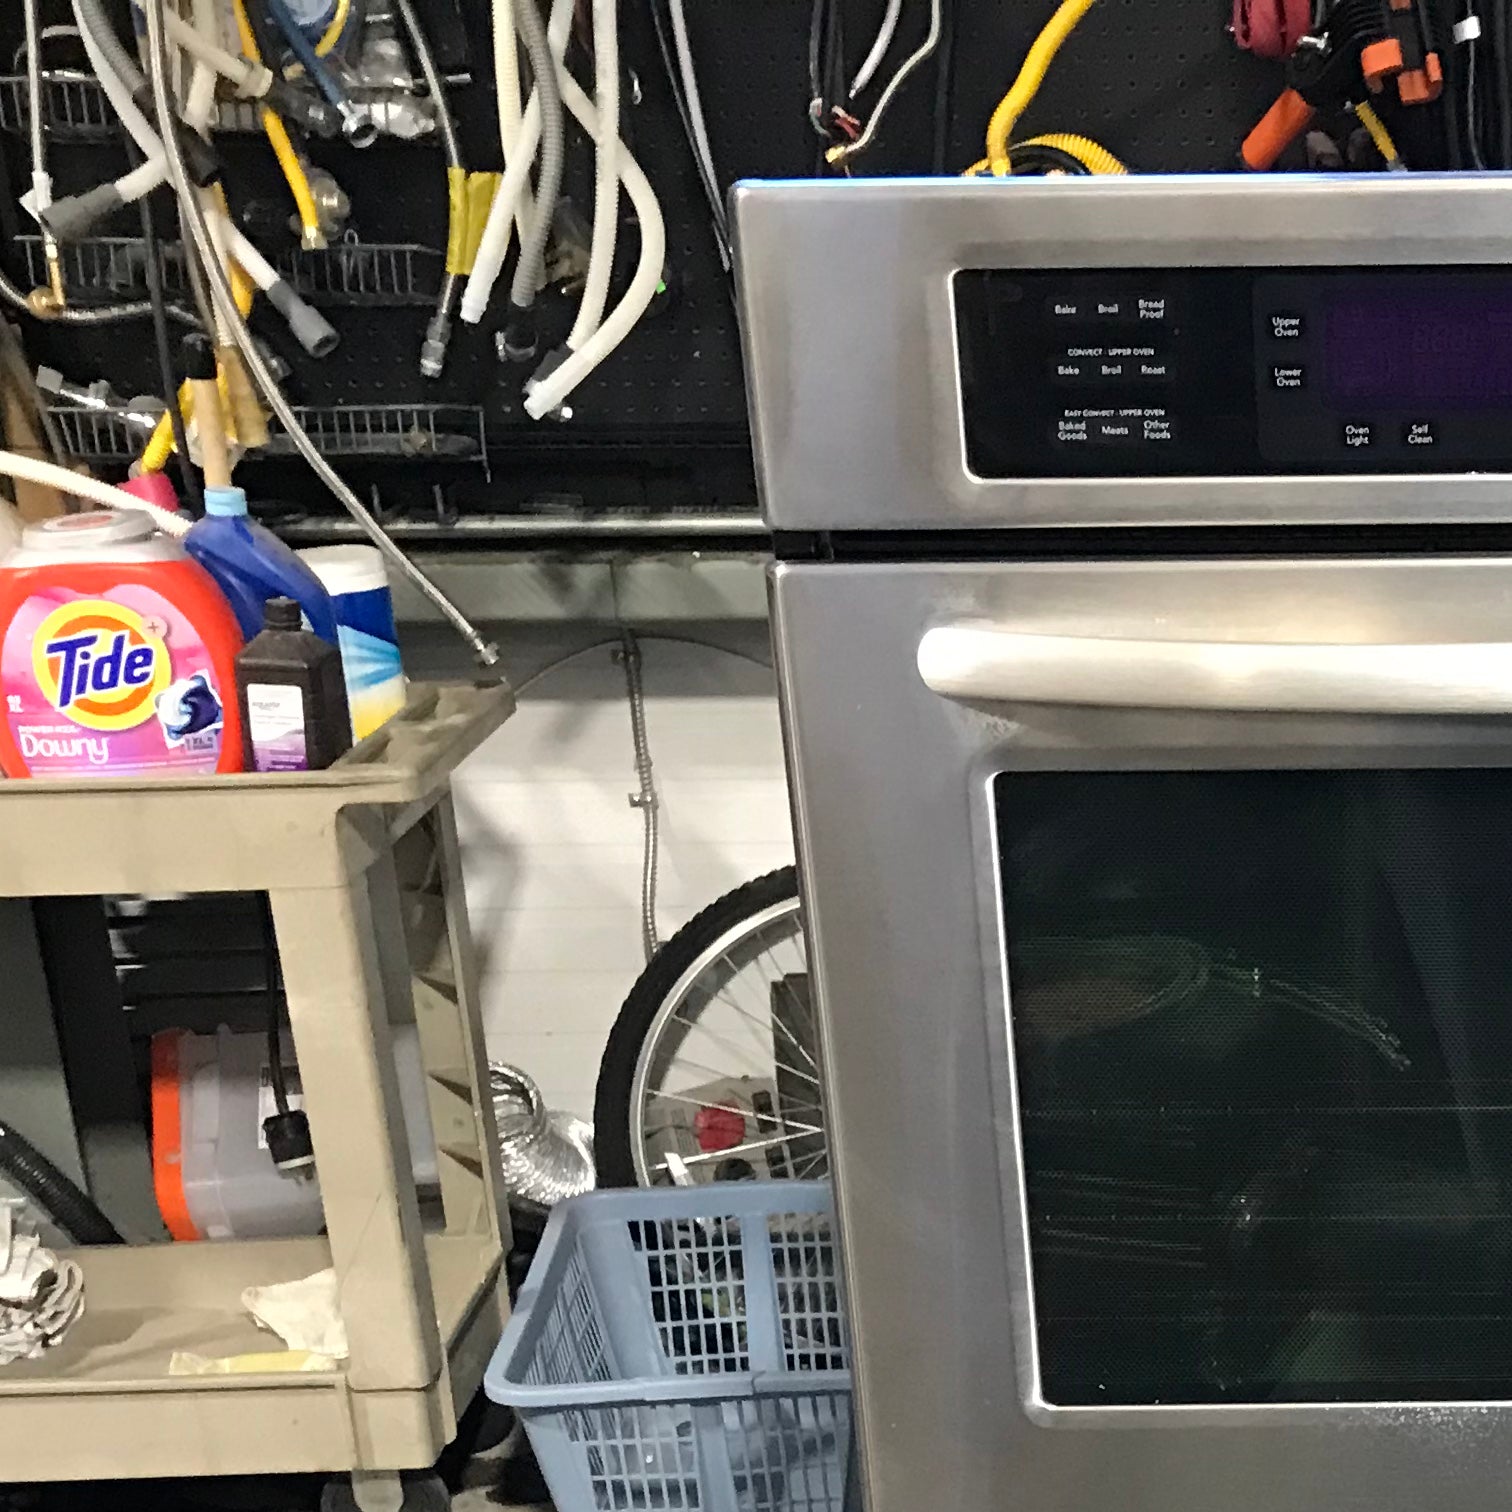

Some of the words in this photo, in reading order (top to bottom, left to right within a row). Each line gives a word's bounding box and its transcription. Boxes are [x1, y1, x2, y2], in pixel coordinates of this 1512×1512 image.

[1054, 304, 1077, 315] Bake
[1139, 309, 1164, 319] Proof
[1272, 317, 1300, 328] Upper
[1274, 327, 1299, 337] Oven
[1108, 348, 1132, 356] UPPER
[1132, 348, 1155, 356] OVEN
[1057, 365, 1080, 375] Bake
[1101, 364, 1122, 375] Broil
[1141, 364, 1166, 375] Roast
[1274, 368, 1302, 377] Lower
[1276, 377, 1301, 387] Oven
[1143, 409, 1166, 417] OVEN
[1058, 421, 1087, 431] Baked
[1143, 420, 1170, 430] Other
[1345, 425, 1370, 435] Oven
[1411, 424, 1429, 434] Self
[1101, 426, 1129, 435] Meats
[1143, 430, 1171, 440] Foods
[1057, 431, 1088, 441] Goods
[1346, 435, 1369, 447] Light
[1407, 434, 1433, 445] Clean
[45, 633, 154, 708] Tide
[20, 734, 109, 765] Downy
